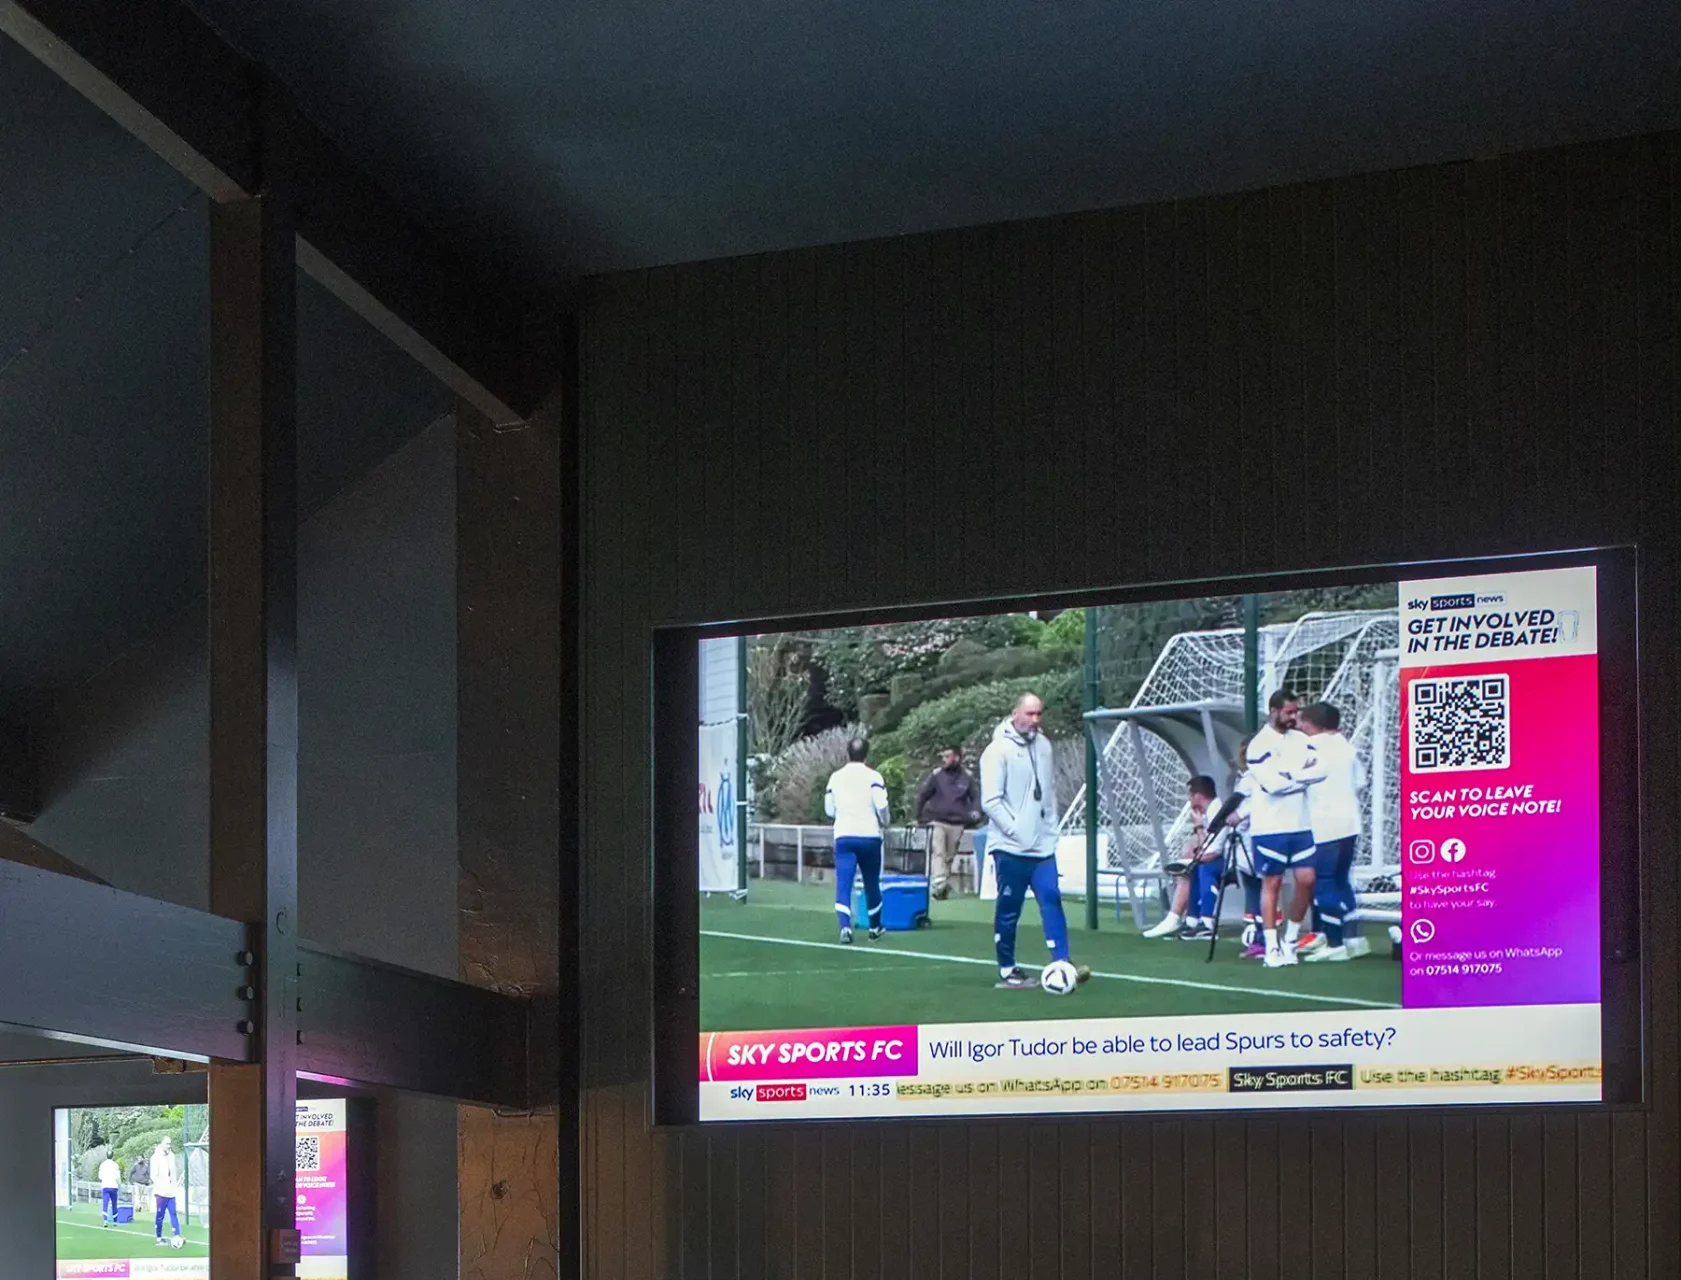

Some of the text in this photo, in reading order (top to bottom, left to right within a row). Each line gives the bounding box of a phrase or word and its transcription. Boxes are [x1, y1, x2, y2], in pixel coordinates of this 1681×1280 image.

[1408, 594, 1504, 611] sky sports news
[1408, 609, 1555, 635] GET INVOLVED
[1407, 628, 1558, 653] IN THE DEBATE!
[1409, 784, 1534, 804] SCAN TO LEAVE
[1410, 800, 1561, 820] YOUR VOICE NOTE!
[1452, 868, 1496, 880] hashtag
[1409, 882, 1489, 895] #SkySportsFC
[1423, 900, 1449, 909] have
[1450, 899, 1474, 910] your
[1409, 946, 1563, 962] Or message us on WhatsApp
[1409, 963, 1502, 976] on 07514 917075
[727, 1039, 903, 1066] SKY SPORTS FC
[929, 1027, 1397, 1062] Will Igor Tudor be able to lead Spurs to safety?
[955, 1083, 973, 1094] us
[1000, 1076, 1081, 1094] WhatsApp
[1110, 1075, 1158, 1090] 07514
[1162, 1073, 1220, 1089] 917075
[1233, 1070, 1348, 1089] Sky Sports FC
[1360, 1070, 1394, 1084] Use
[1397, 1068, 1426, 1082] the
[1430, 1066, 1501, 1084] hashtag
[730, 1083, 891, 1101] sky sports news 11:35
